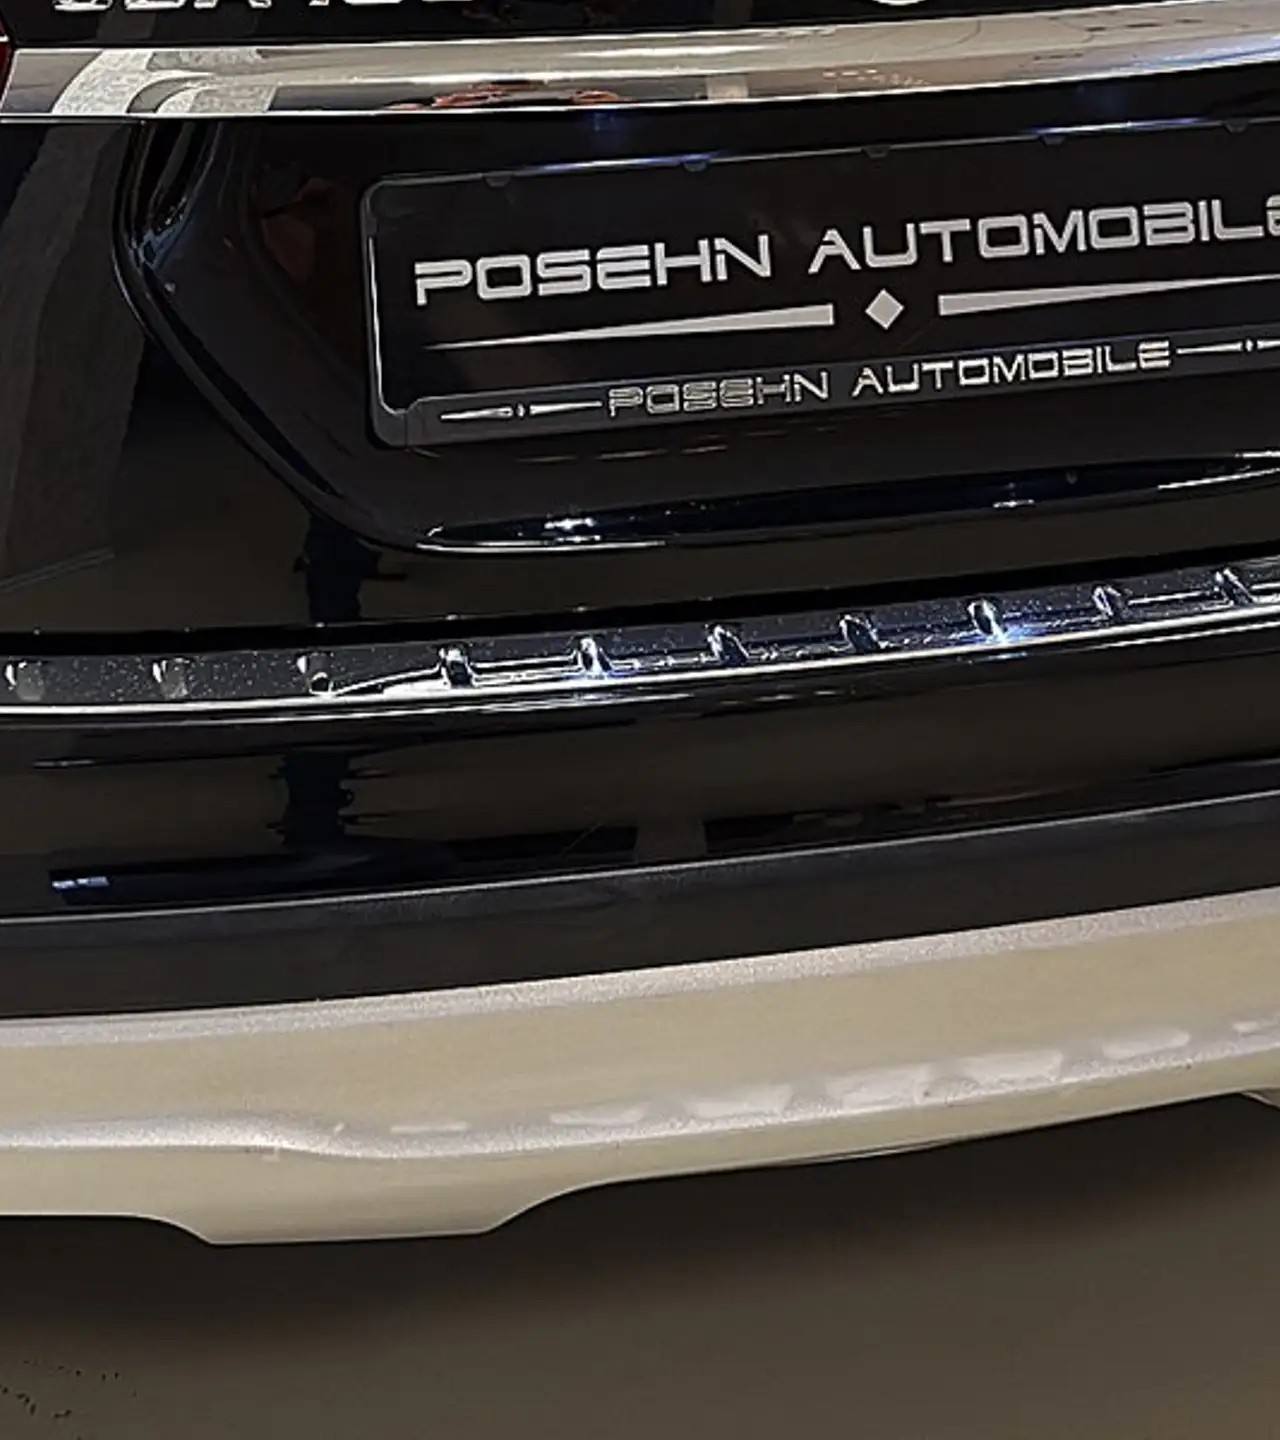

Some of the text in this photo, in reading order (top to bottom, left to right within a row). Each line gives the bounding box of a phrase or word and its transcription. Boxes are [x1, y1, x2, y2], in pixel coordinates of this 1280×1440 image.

[414, 233, 772, 306] POSEHN
[608, 339, 1171, 418] POSEHN AUTOMOBILE
